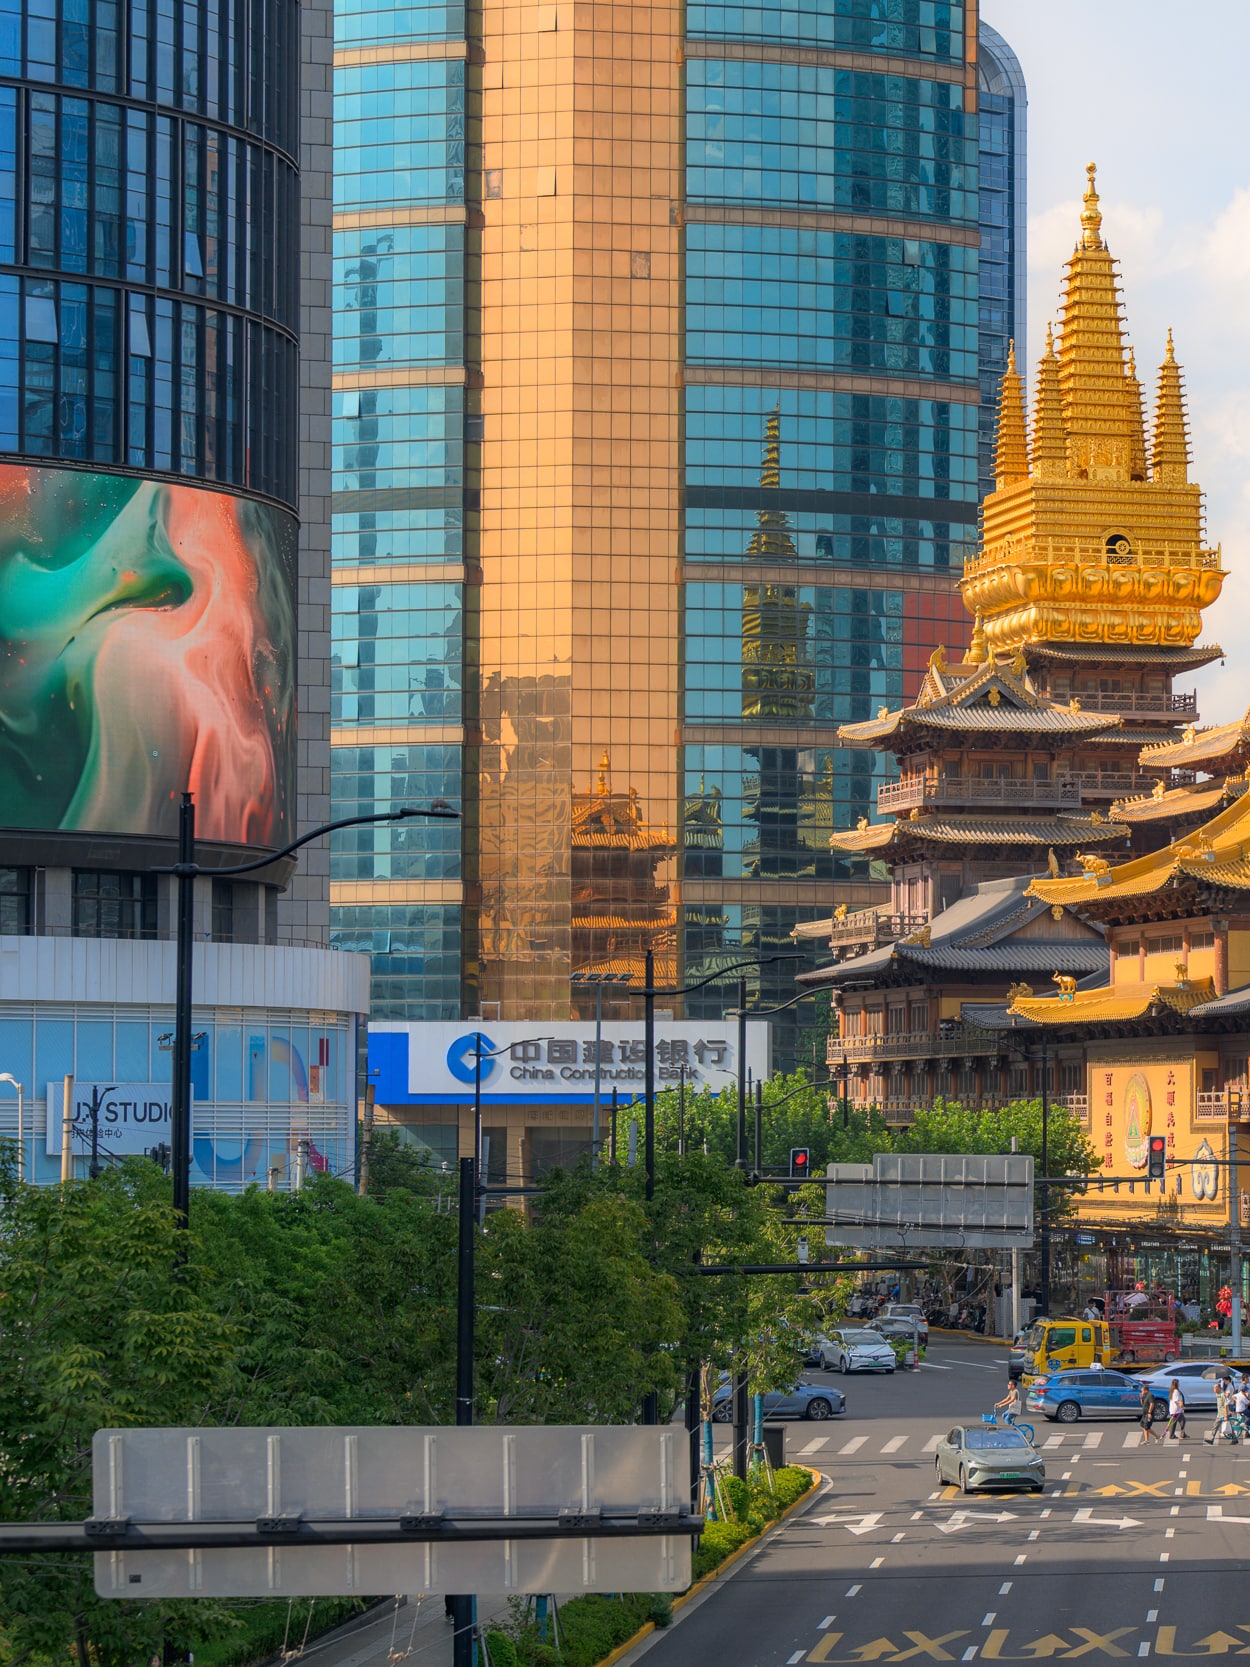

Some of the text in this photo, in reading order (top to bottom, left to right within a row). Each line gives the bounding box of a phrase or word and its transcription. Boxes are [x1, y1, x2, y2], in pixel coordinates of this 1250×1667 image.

[510, 1039, 728, 1065] 中国建设银行
[510, 1066, 698, 1081] China Constructio Bank
